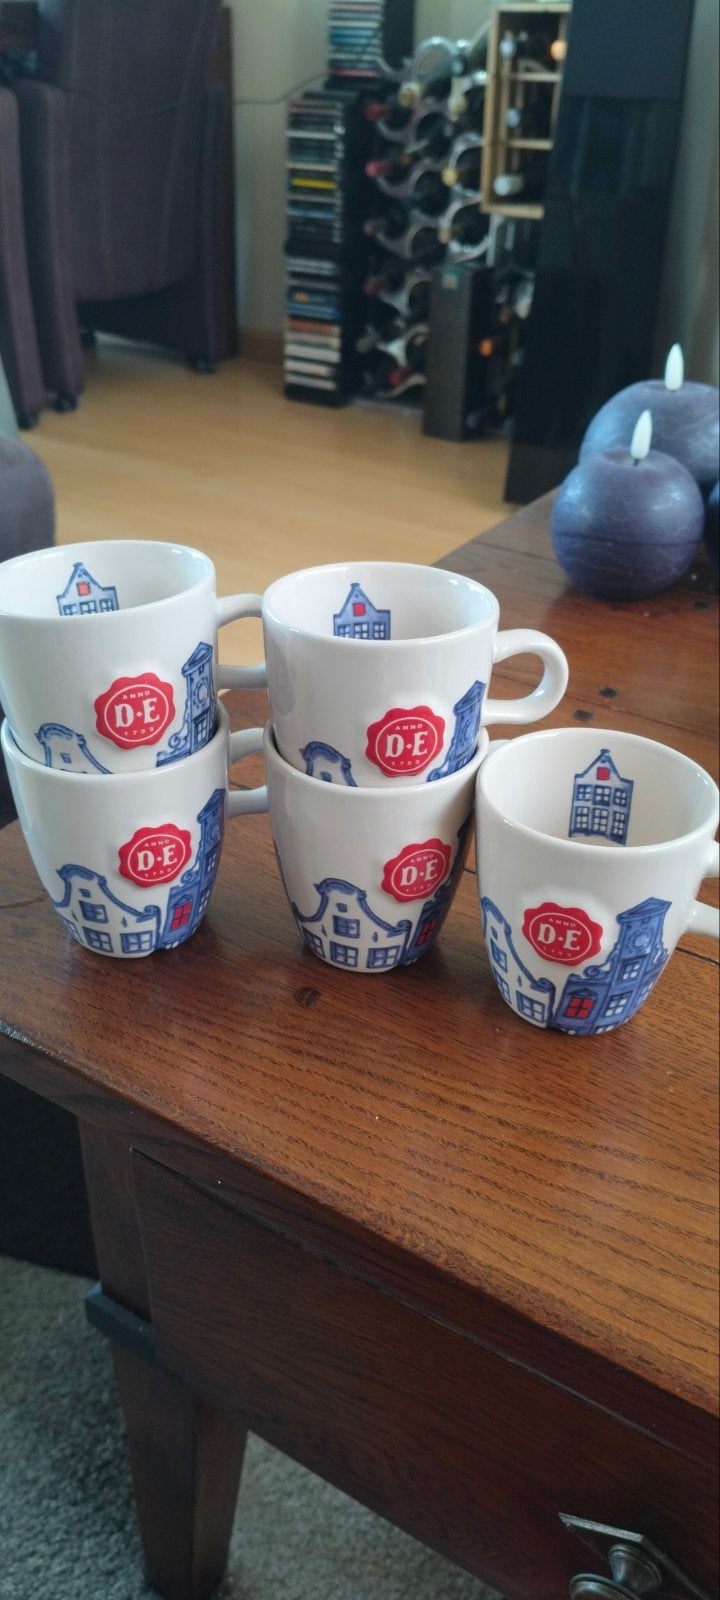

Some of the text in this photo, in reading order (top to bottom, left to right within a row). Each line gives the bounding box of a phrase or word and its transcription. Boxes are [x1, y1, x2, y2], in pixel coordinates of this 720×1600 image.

[122, 690, 151, 700] ANNO
[123, 726, 154, 737] 1753
[395, 723, 424, 731] ANNO
[144, 839, 170, 848] ANNO
